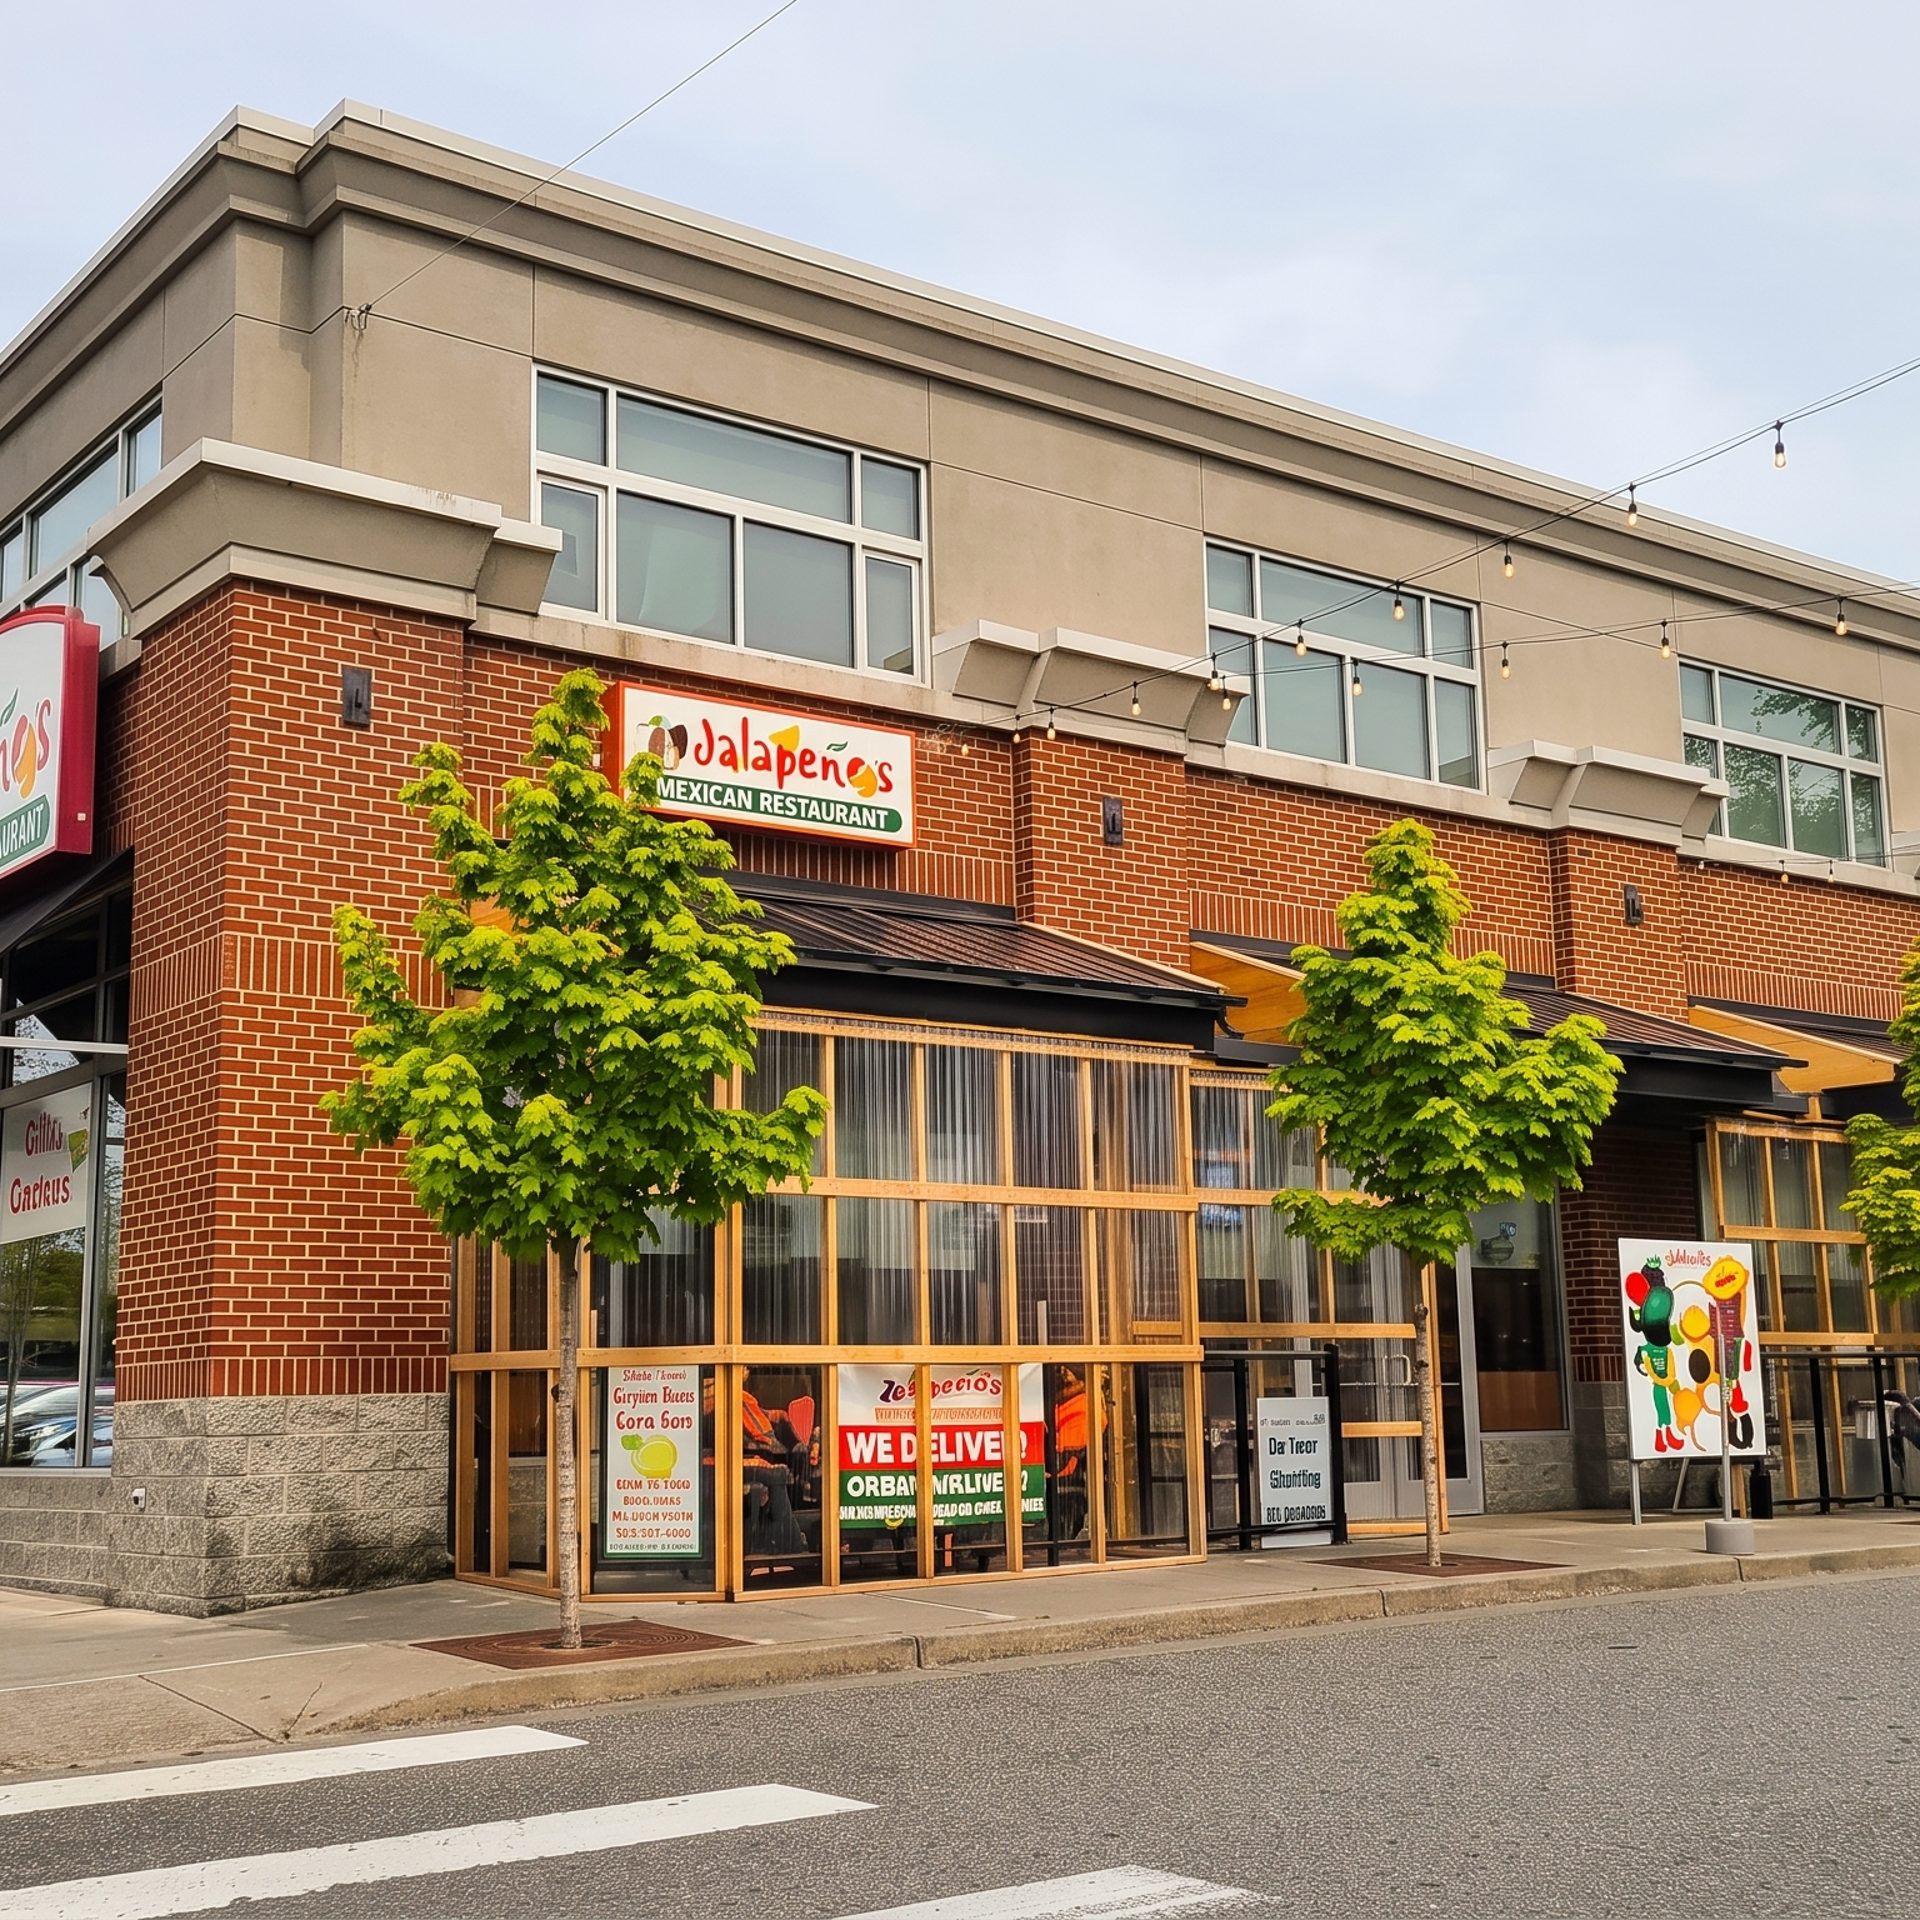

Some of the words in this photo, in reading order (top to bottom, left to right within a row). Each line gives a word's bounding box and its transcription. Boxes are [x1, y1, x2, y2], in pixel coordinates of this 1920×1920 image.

[656, 776, 753, 810] MEXICAN
[759, 791, 888, 829] RESTAURANT
[0, 803, 44, 860] URANT
[846, 1432, 895, 1465] WE
